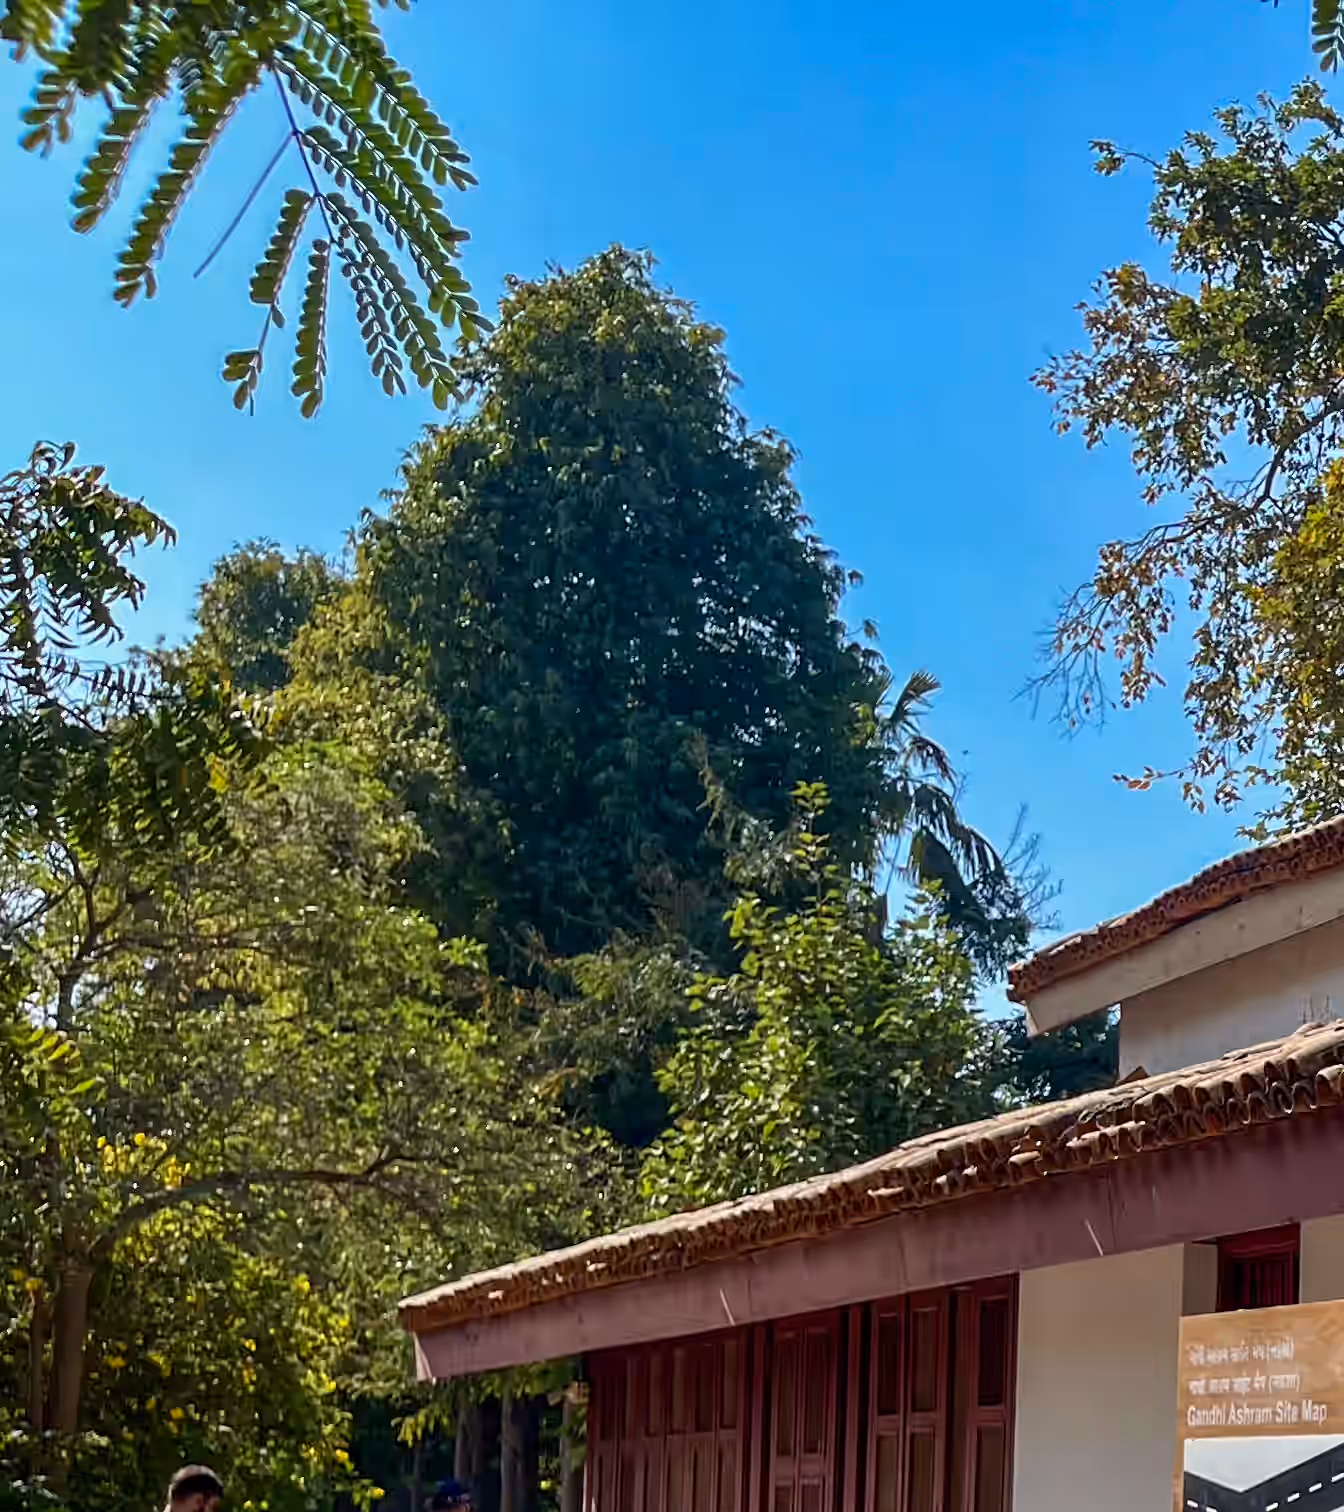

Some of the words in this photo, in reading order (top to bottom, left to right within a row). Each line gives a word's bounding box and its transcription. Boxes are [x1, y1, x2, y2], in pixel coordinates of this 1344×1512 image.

[1187, 1402, 1226, 1426] Gandhi
[1228, 1401, 1273, 1425] Ashram
[1275, 1400, 1299, 1424] Site
[1301, 1399, 1328, 1426] Map
